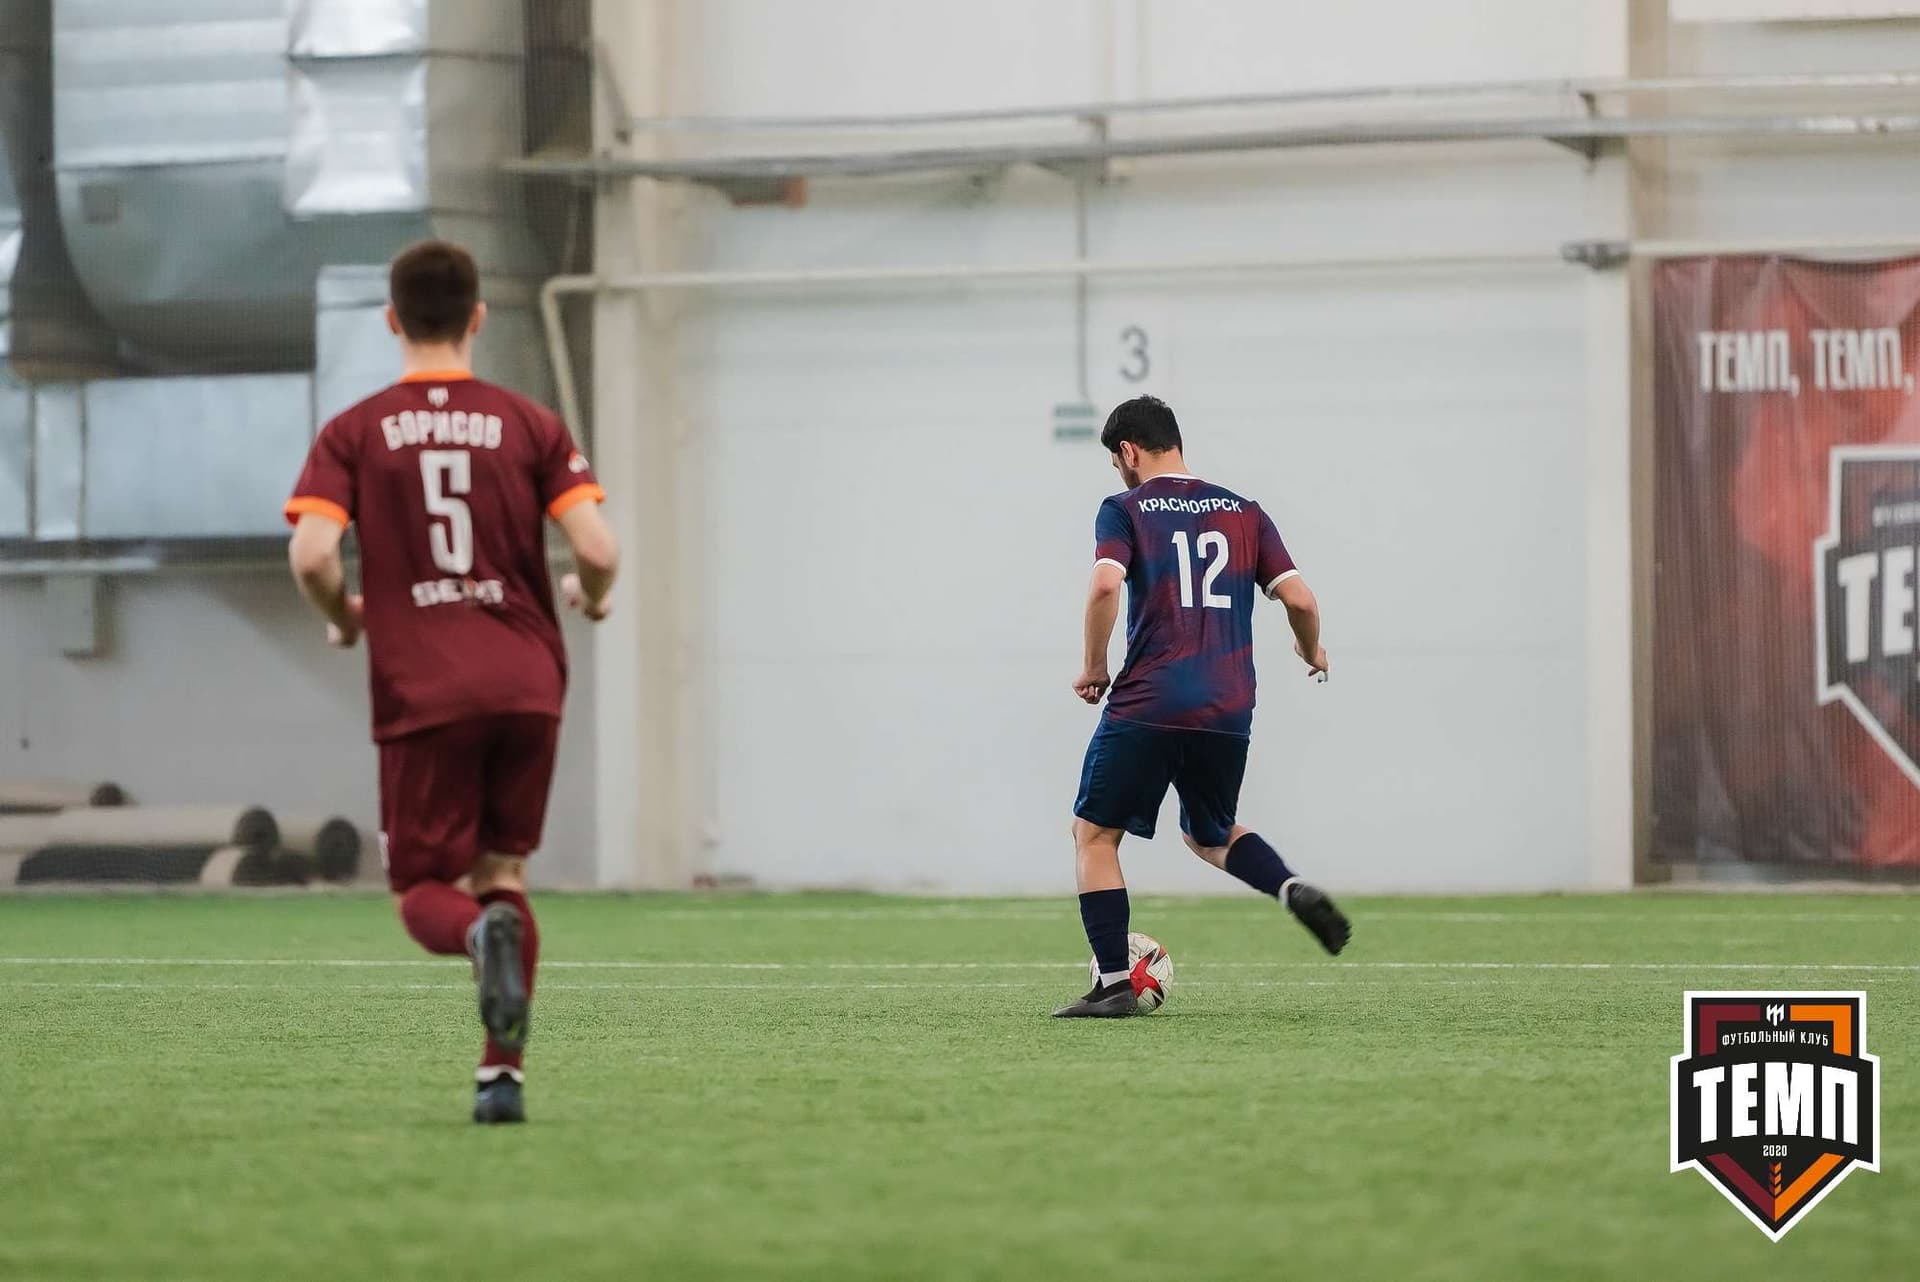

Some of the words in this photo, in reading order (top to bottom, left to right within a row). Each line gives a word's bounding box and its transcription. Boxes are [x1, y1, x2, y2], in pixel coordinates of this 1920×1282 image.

[1120, 325, 1150, 382] 3
[1698, 330, 1800, 398] ТЕМП,
[1809, 327, 1914, 397] ТЕМП,
[381, 410, 503, 450] БОРИСОВ
[420, 450, 473, 575] 5
[1138, 497, 1243, 514] КРАСНОЯРСК
[1171, 531, 1231, 609] 12
[1837, 546, 1920, 664] ТЕ
